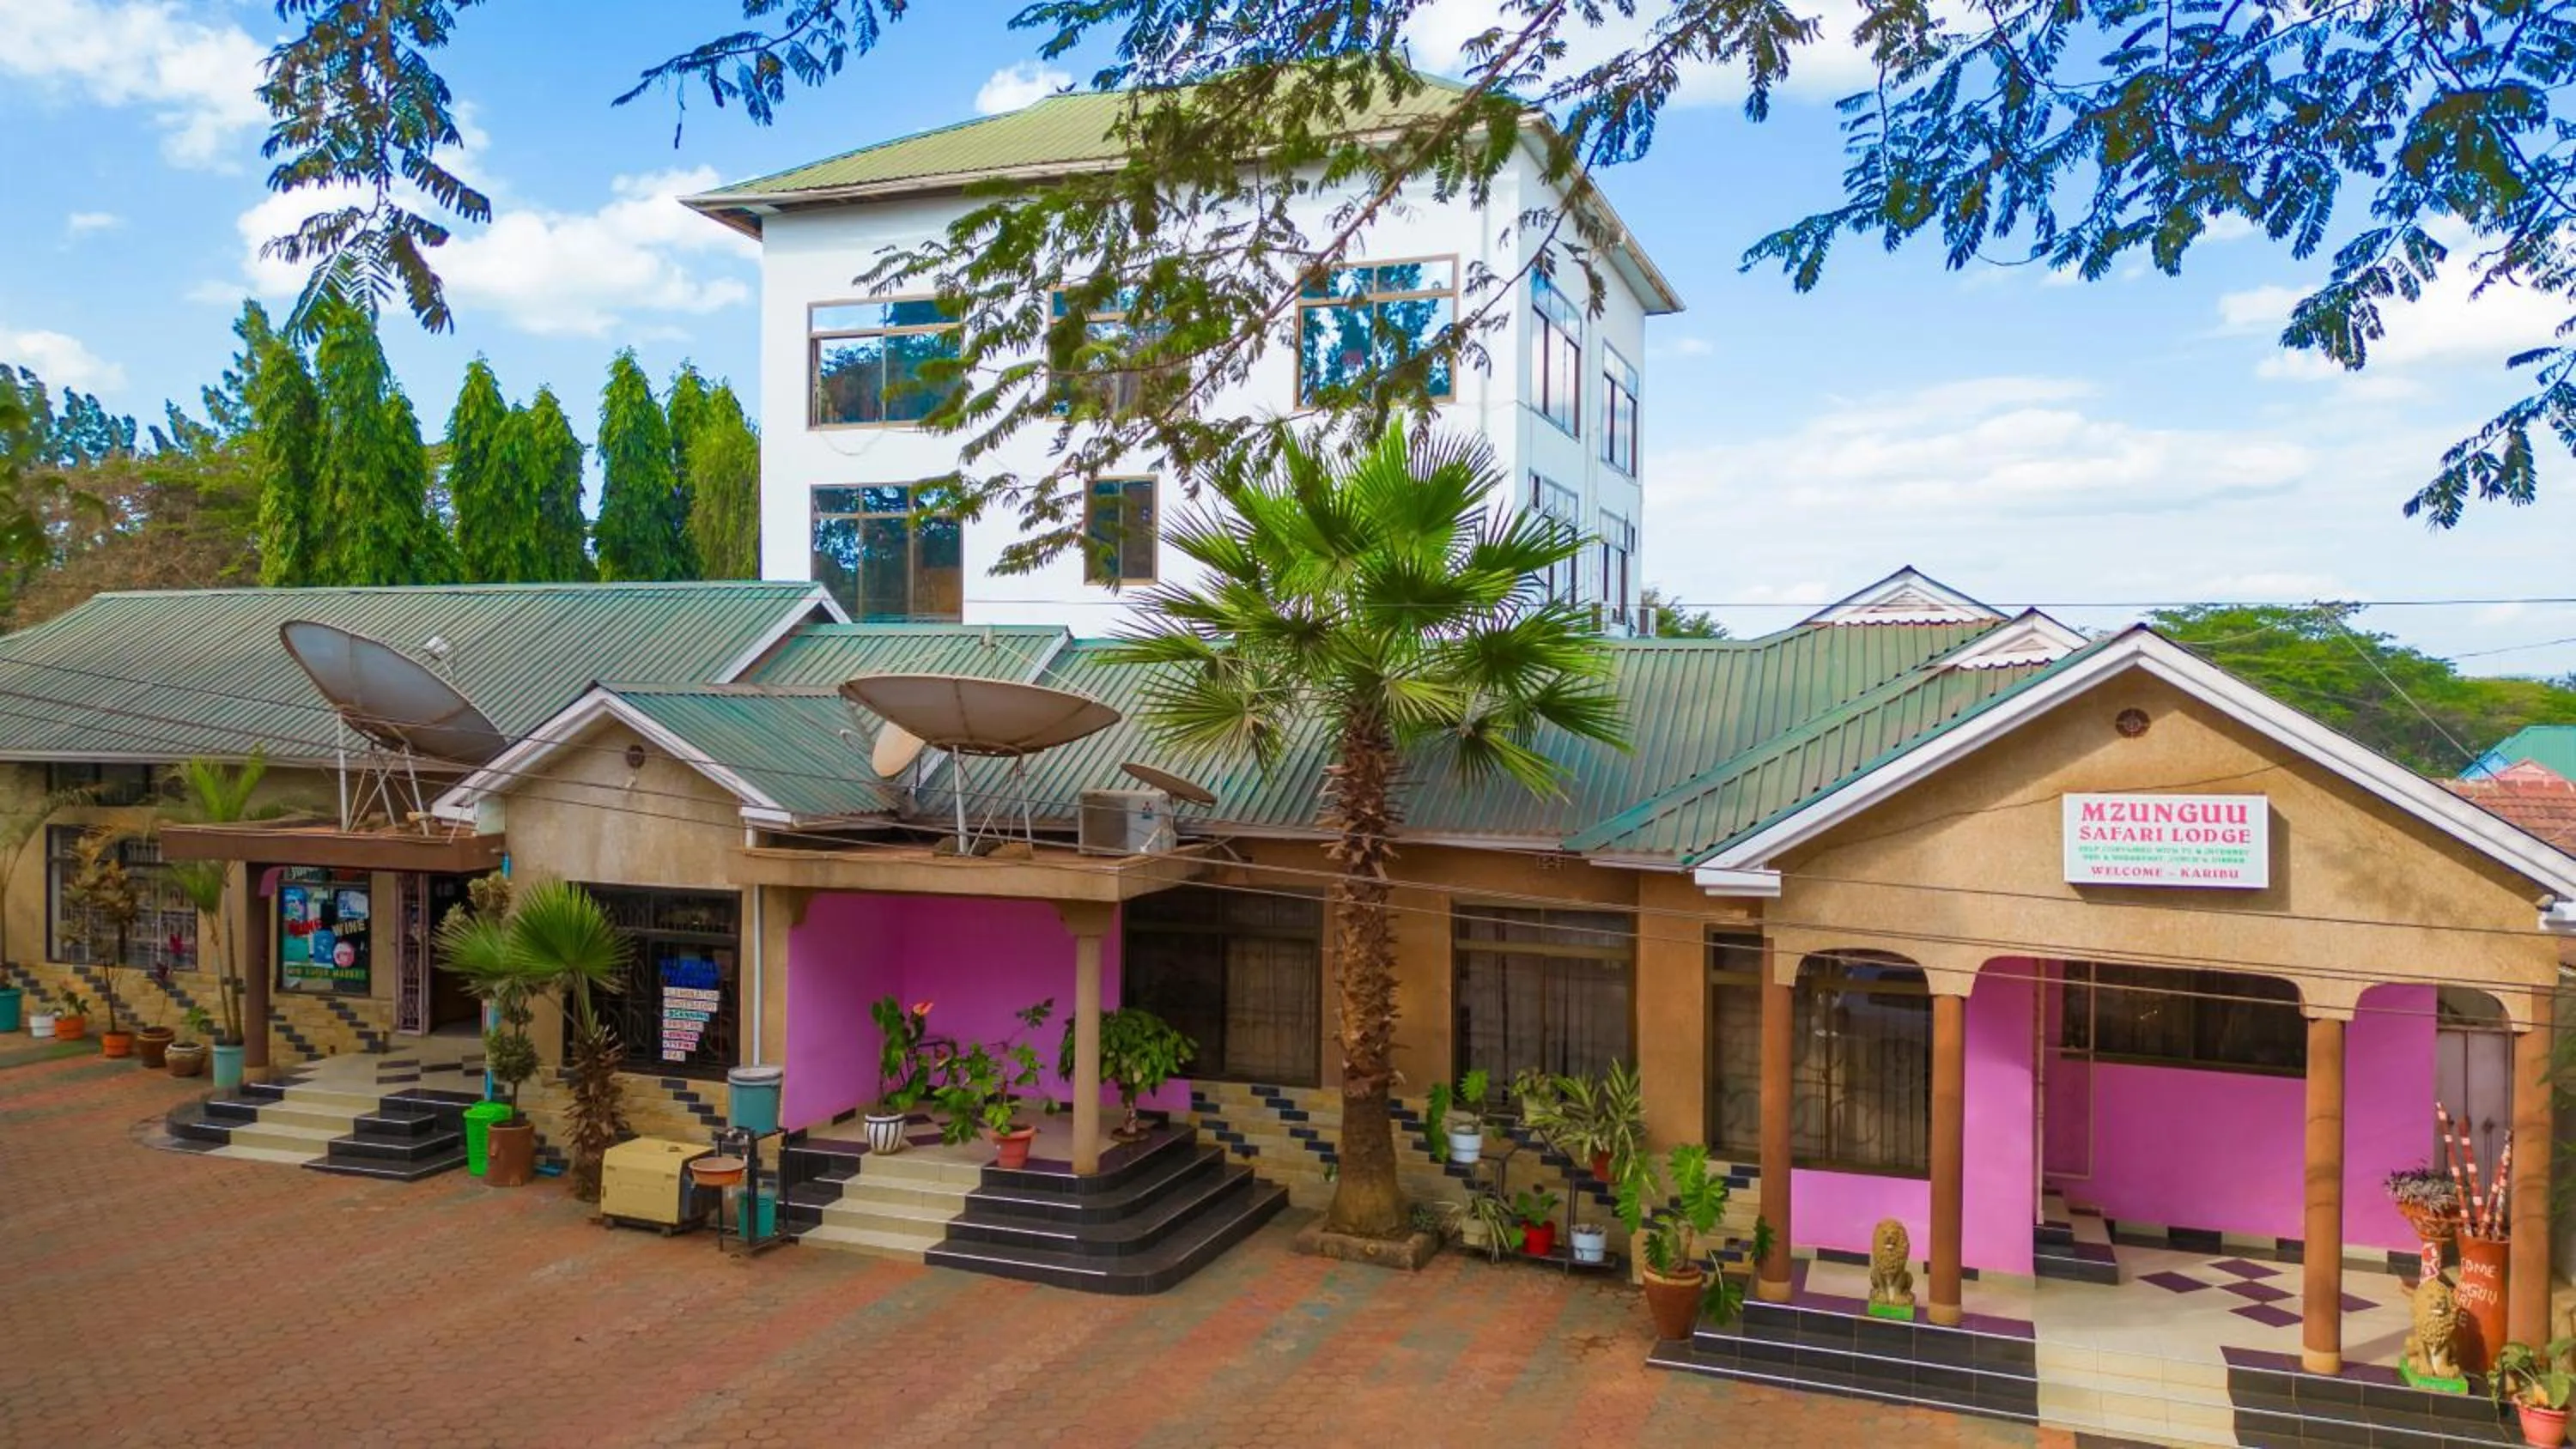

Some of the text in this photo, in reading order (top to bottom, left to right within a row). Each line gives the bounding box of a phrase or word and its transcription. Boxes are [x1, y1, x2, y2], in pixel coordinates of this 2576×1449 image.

[2081, 803, 2248, 825] MZUNGUU
[2079, 826, 2251, 844] SAFARI LODGE
[2091, 866, 2163, 877] WELCOME
[2180, 868, 2239, 880] KARIBU
[332, 920, 366, 937] WINE
